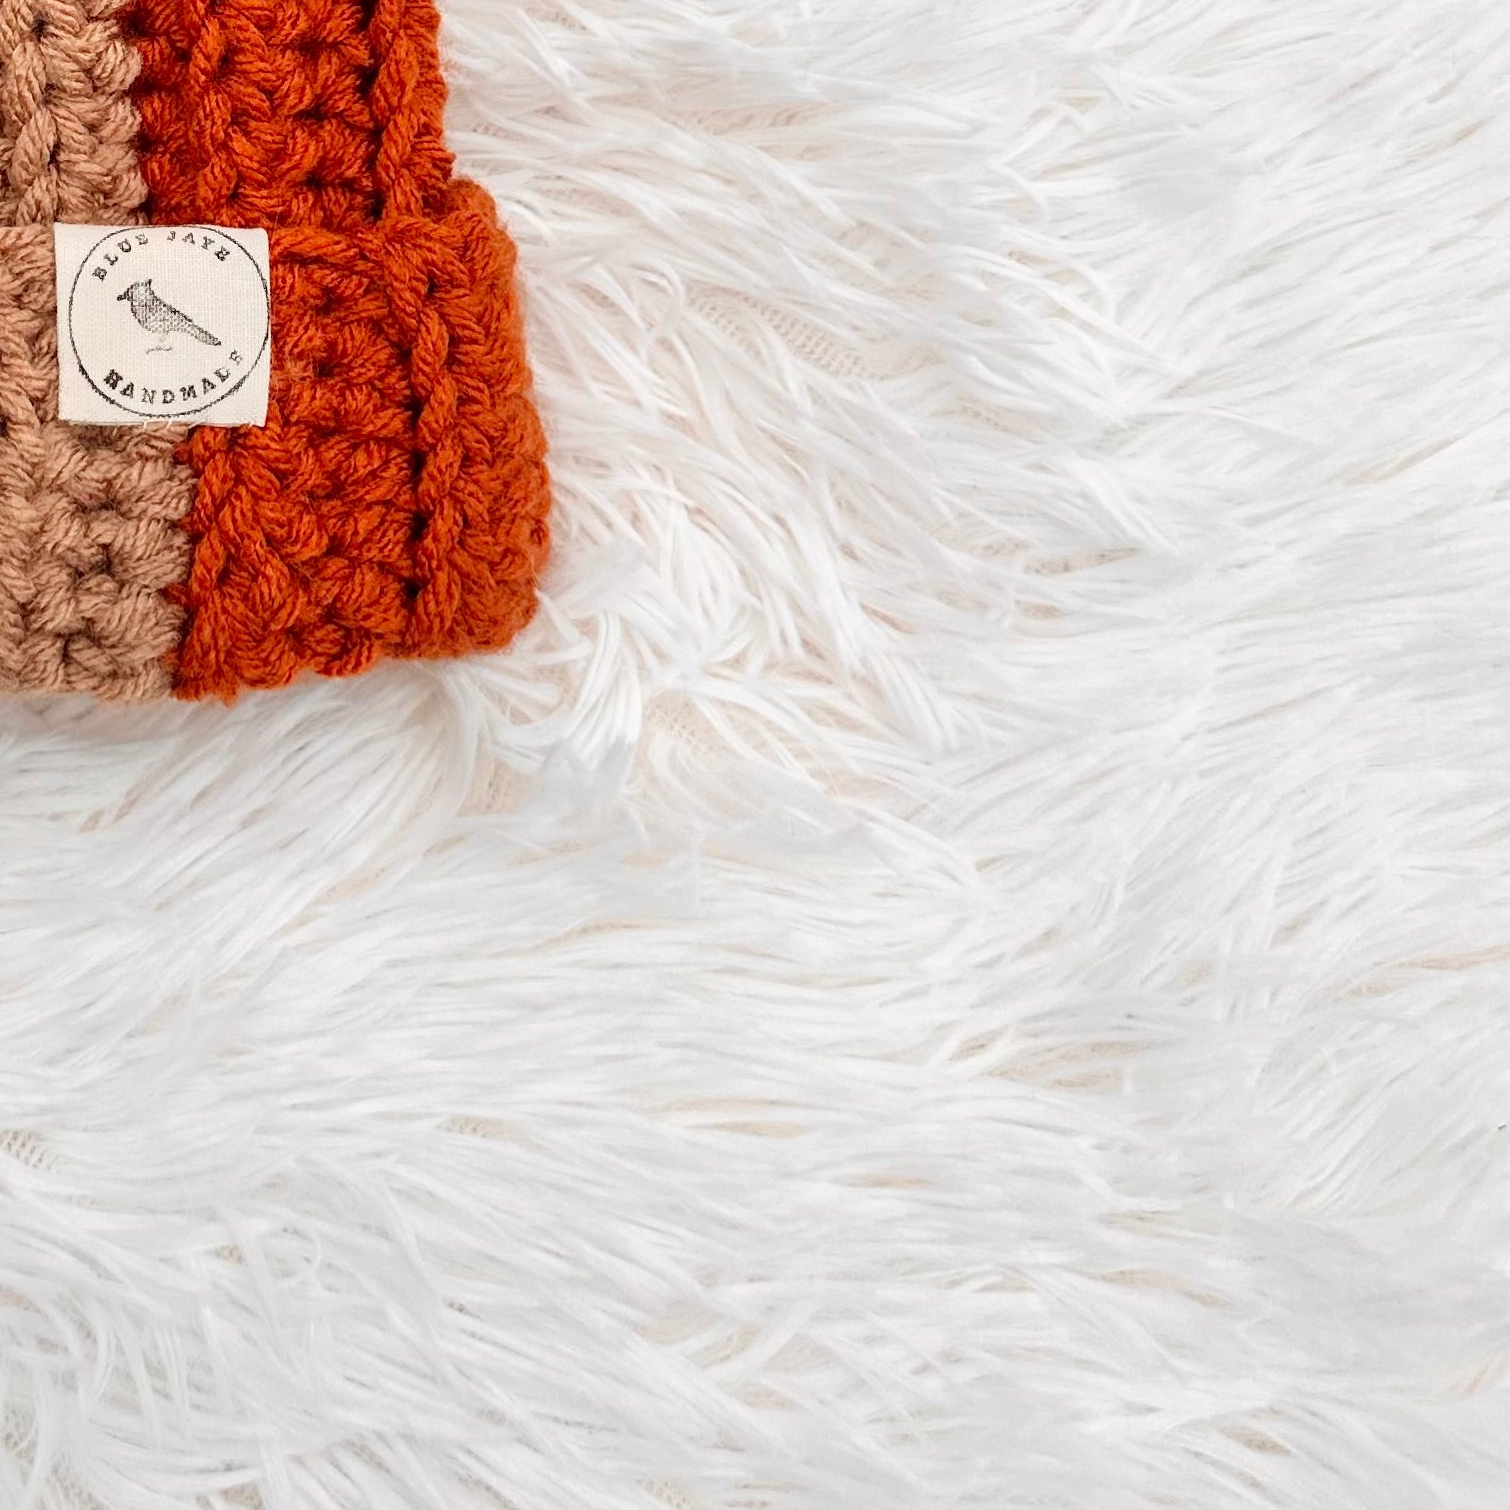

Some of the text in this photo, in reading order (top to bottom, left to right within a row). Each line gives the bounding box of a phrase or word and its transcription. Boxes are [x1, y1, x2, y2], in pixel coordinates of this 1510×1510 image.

[92, 230, 230, 281] BLUE JAYE
[104, 349, 243, 404] HANDMADE
